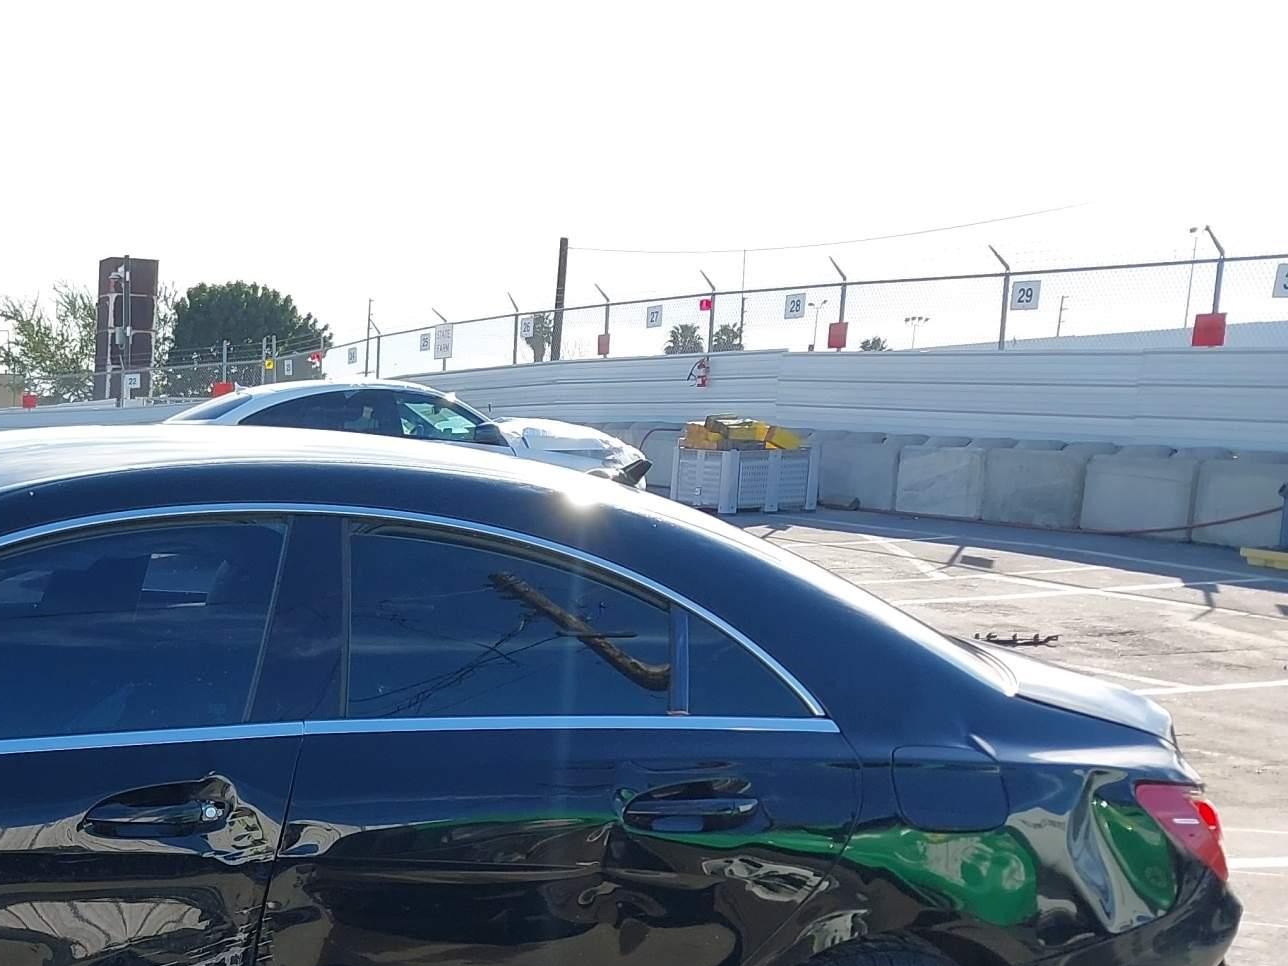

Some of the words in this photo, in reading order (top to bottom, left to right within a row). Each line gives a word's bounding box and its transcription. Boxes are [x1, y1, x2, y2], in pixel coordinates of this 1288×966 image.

[1017, 287, 1033, 303] 29
[789, 299, 801, 313] 28
[650, 311, 660, 323] 27
[522, 322, 531, 333] 26
[437, 329, 451, 338] STATE
[436, 343, 450, 352] FARM
[128, 377, 137, 386] 22
